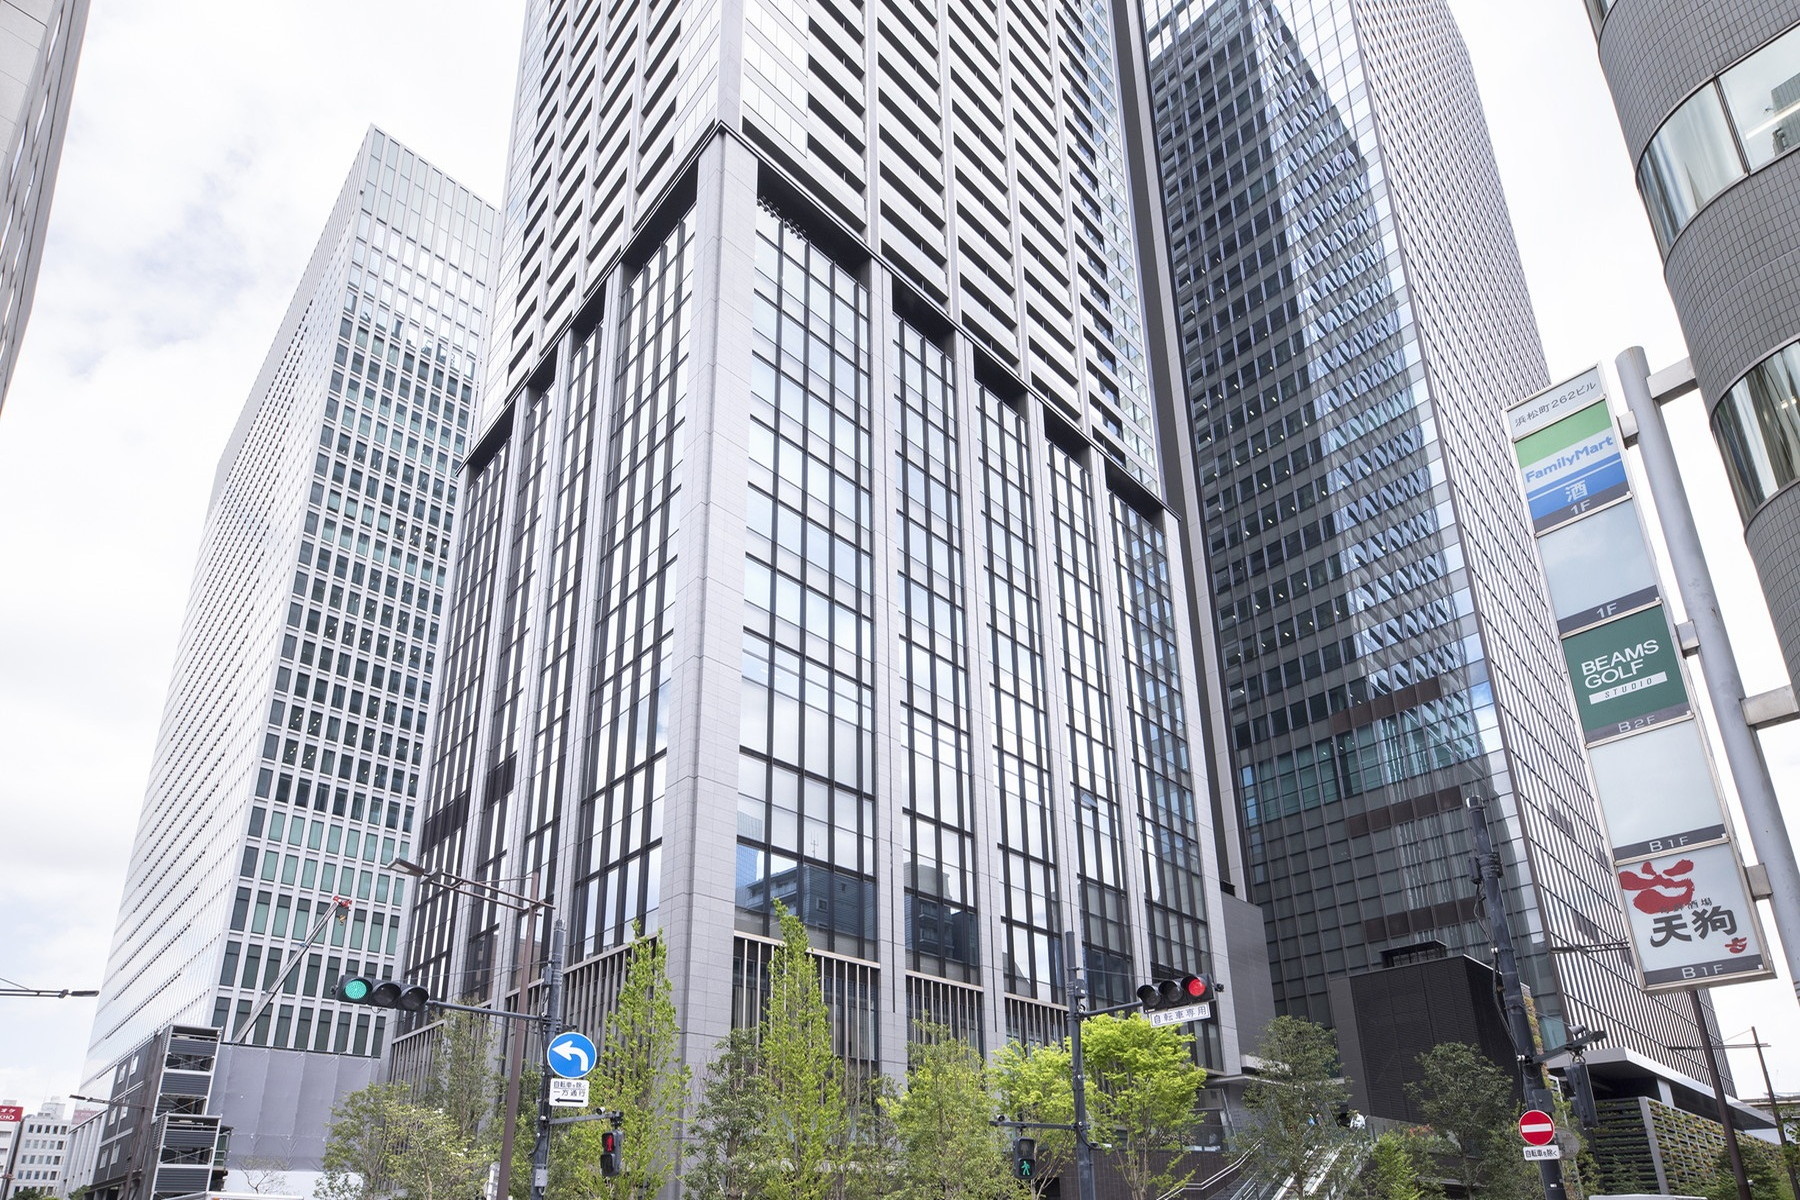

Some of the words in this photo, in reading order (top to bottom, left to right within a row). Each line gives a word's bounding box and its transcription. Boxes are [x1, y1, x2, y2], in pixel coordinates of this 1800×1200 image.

[1515, 382, 1597, 427] 浜松町262ビル
[1525, 435, 1613, 483] FamilyMart
[1564, 480, 1588, 502] 酒
[1570, 500, 1591, 515] 1F
[1596, 602, 1617, 618] 1F
[1581, 639, 1660, 676] BEAMS
[1584, 658, 1644, 689] GOLF
[1604, 677, 1653, 699] STUDIO
[1618, 714, 1656, 733] B2F
[1648, 836, 1689, 853] B1F
[1649, 905, 1738, 948] 天狗
[1681, 964, 1724, 979] B1F
[1153, 1005, 1207, 1025] 自転車専用
[553, 1089, 586, 1098] 一方通行
